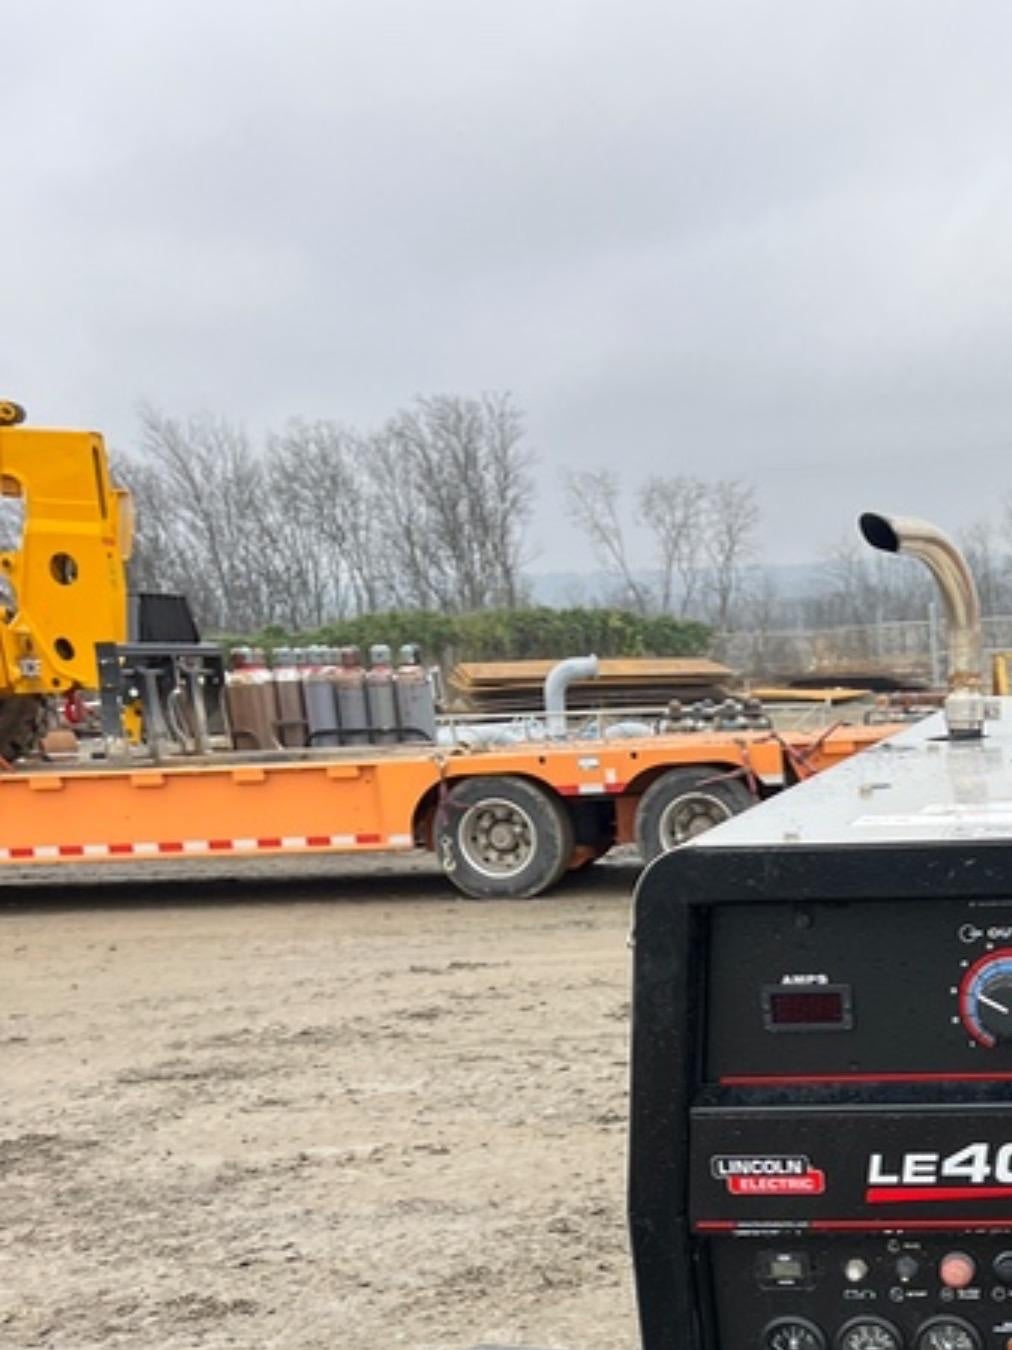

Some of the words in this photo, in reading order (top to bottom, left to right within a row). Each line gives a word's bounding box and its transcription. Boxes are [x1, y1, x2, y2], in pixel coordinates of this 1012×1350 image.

[781, 973, 829, 985] AMPS
[717, 1159, 803, 1175] LINCOLN
[739, 1178, 816, 1191] ELECTRIC
